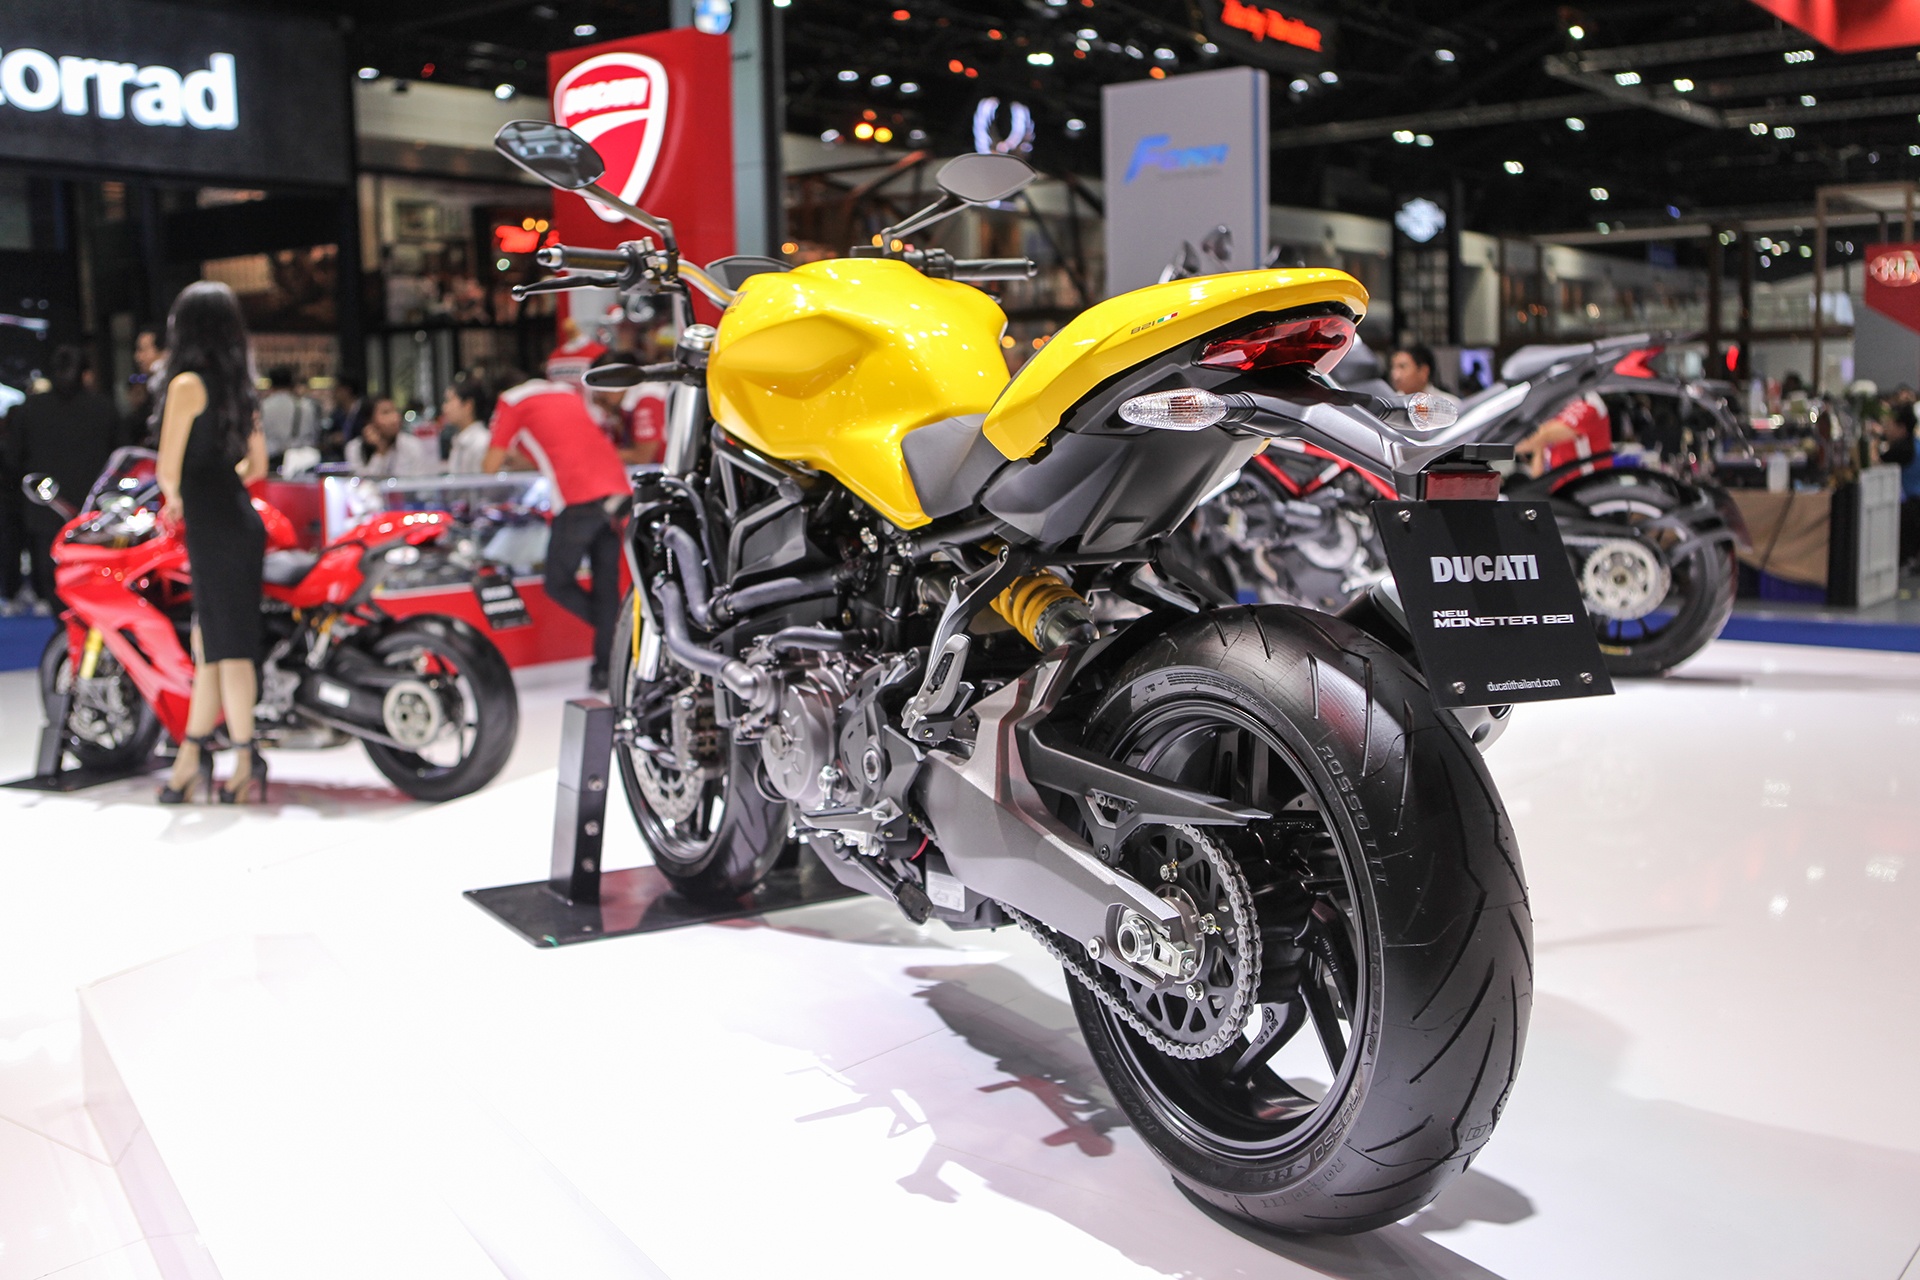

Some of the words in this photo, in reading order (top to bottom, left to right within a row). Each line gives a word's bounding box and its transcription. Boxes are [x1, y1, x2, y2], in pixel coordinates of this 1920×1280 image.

[0, 48, 239, 131] orrad
[1430, 554, 1539, 583] DUCATI
[1432, 609, 1469, 618] NEW
[1434, 615, 1539, 628] MONSTER
[1542, 614, 1575, 625] 821
[1487, 677, 1561, 692] ducatithailand.com
[1316, 745, 1370, 830] ROSSO
